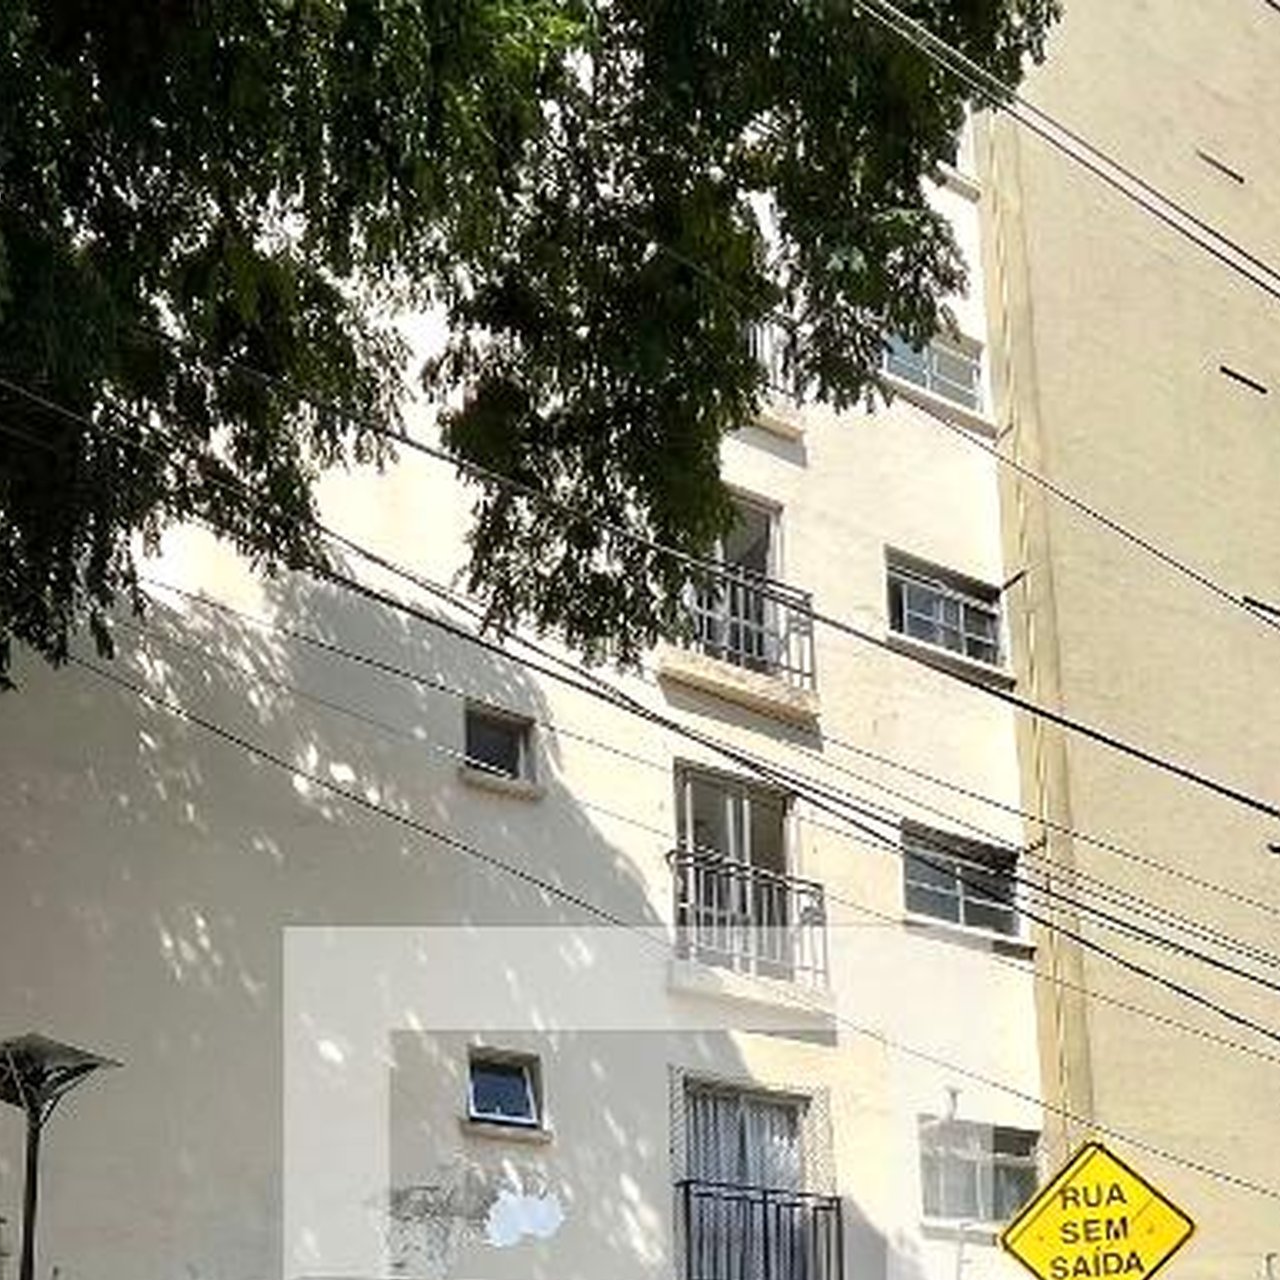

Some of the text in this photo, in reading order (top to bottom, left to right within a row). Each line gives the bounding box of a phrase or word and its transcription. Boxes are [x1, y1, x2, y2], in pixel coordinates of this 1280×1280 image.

[1060, 1183, 1128, 1210] RUA
[1060, 1216, 1129, 1245] SEM
[1050, 1246, 1145, 1280] SAÍDA
